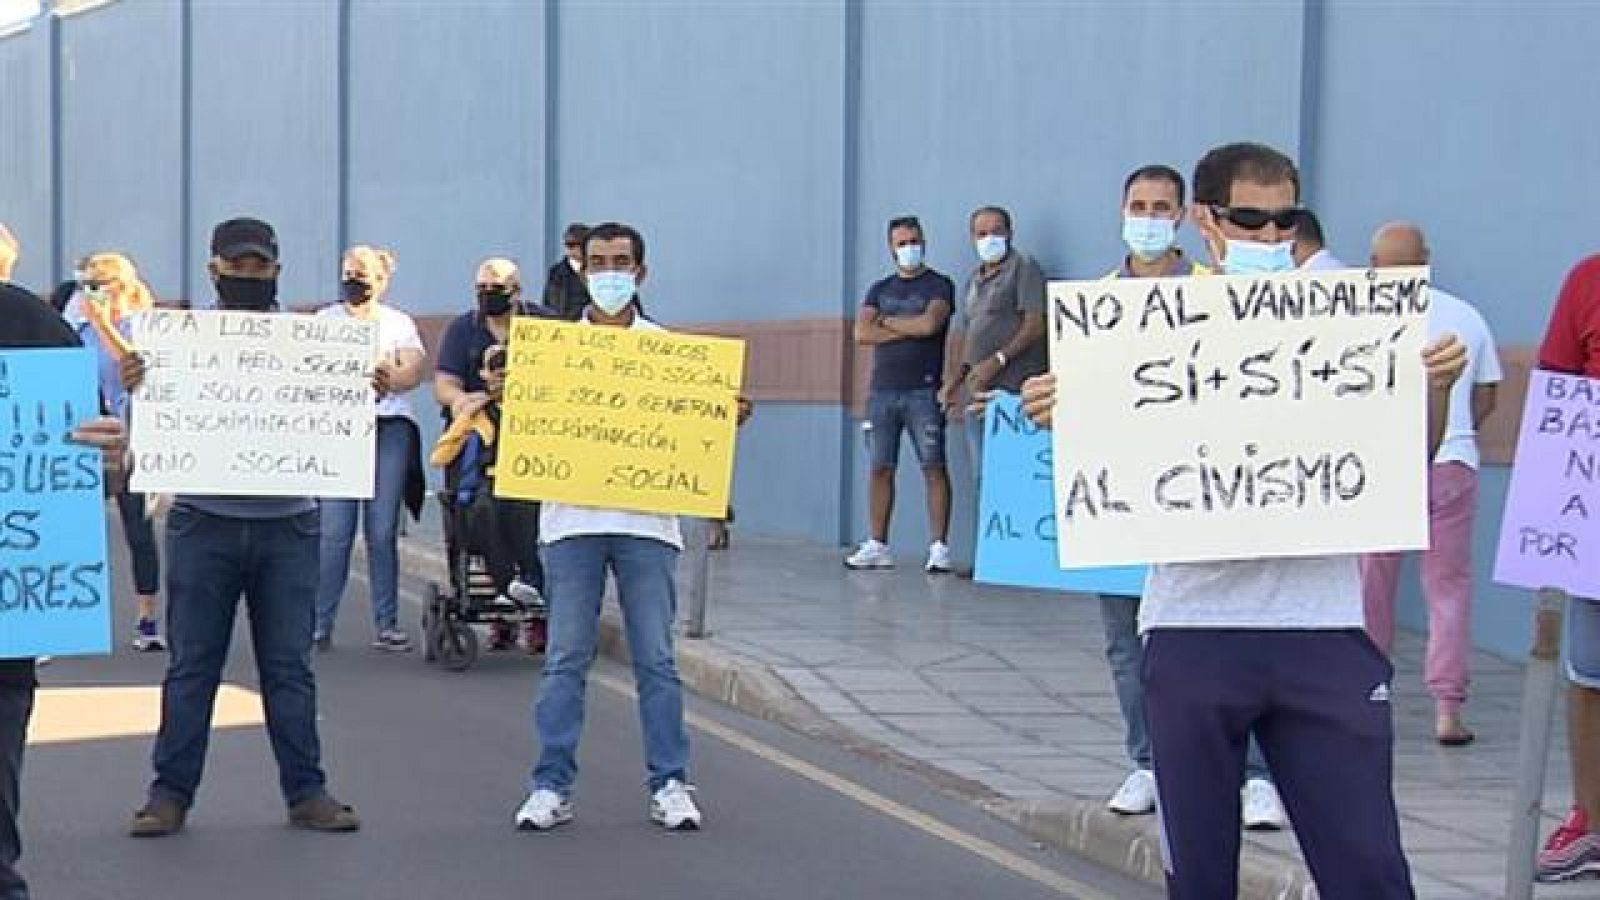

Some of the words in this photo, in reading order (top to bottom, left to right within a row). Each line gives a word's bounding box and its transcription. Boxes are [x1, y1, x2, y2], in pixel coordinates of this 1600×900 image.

[180, 312, 200, 336] A
[220, 314, 272, 337] LOS
[1055, 294, 1123, 340] NO
[1139, 283, 1209, 332] AL
[513, 324, 542, 343] NO
[549, 326, 565, 343] A
[579, 329, 618, 353] LOS
[190, 349, 220, 371] LA
[237, 349, 283, 371] RED
[563, 354, 595, 373] LA
[611, 357, 655, 381] RED
[507, 380, 560, 403] QUE
[1545, 377, 1600, 406] BA
[1538, 407, 1600, 438] BA
[700, 438, 716, 453] Y
[230, 449, 341, 478] SOCIAL
[1564, 449, 1600, 482] N
[604, 463, 710, 496] SOCIAL
[1065, 466, 1132, 521] AL
[1560, 494, 1588, 519] A
[985, 510, 1021, 541] AL
[1520, 526, 1579, 561] POR
